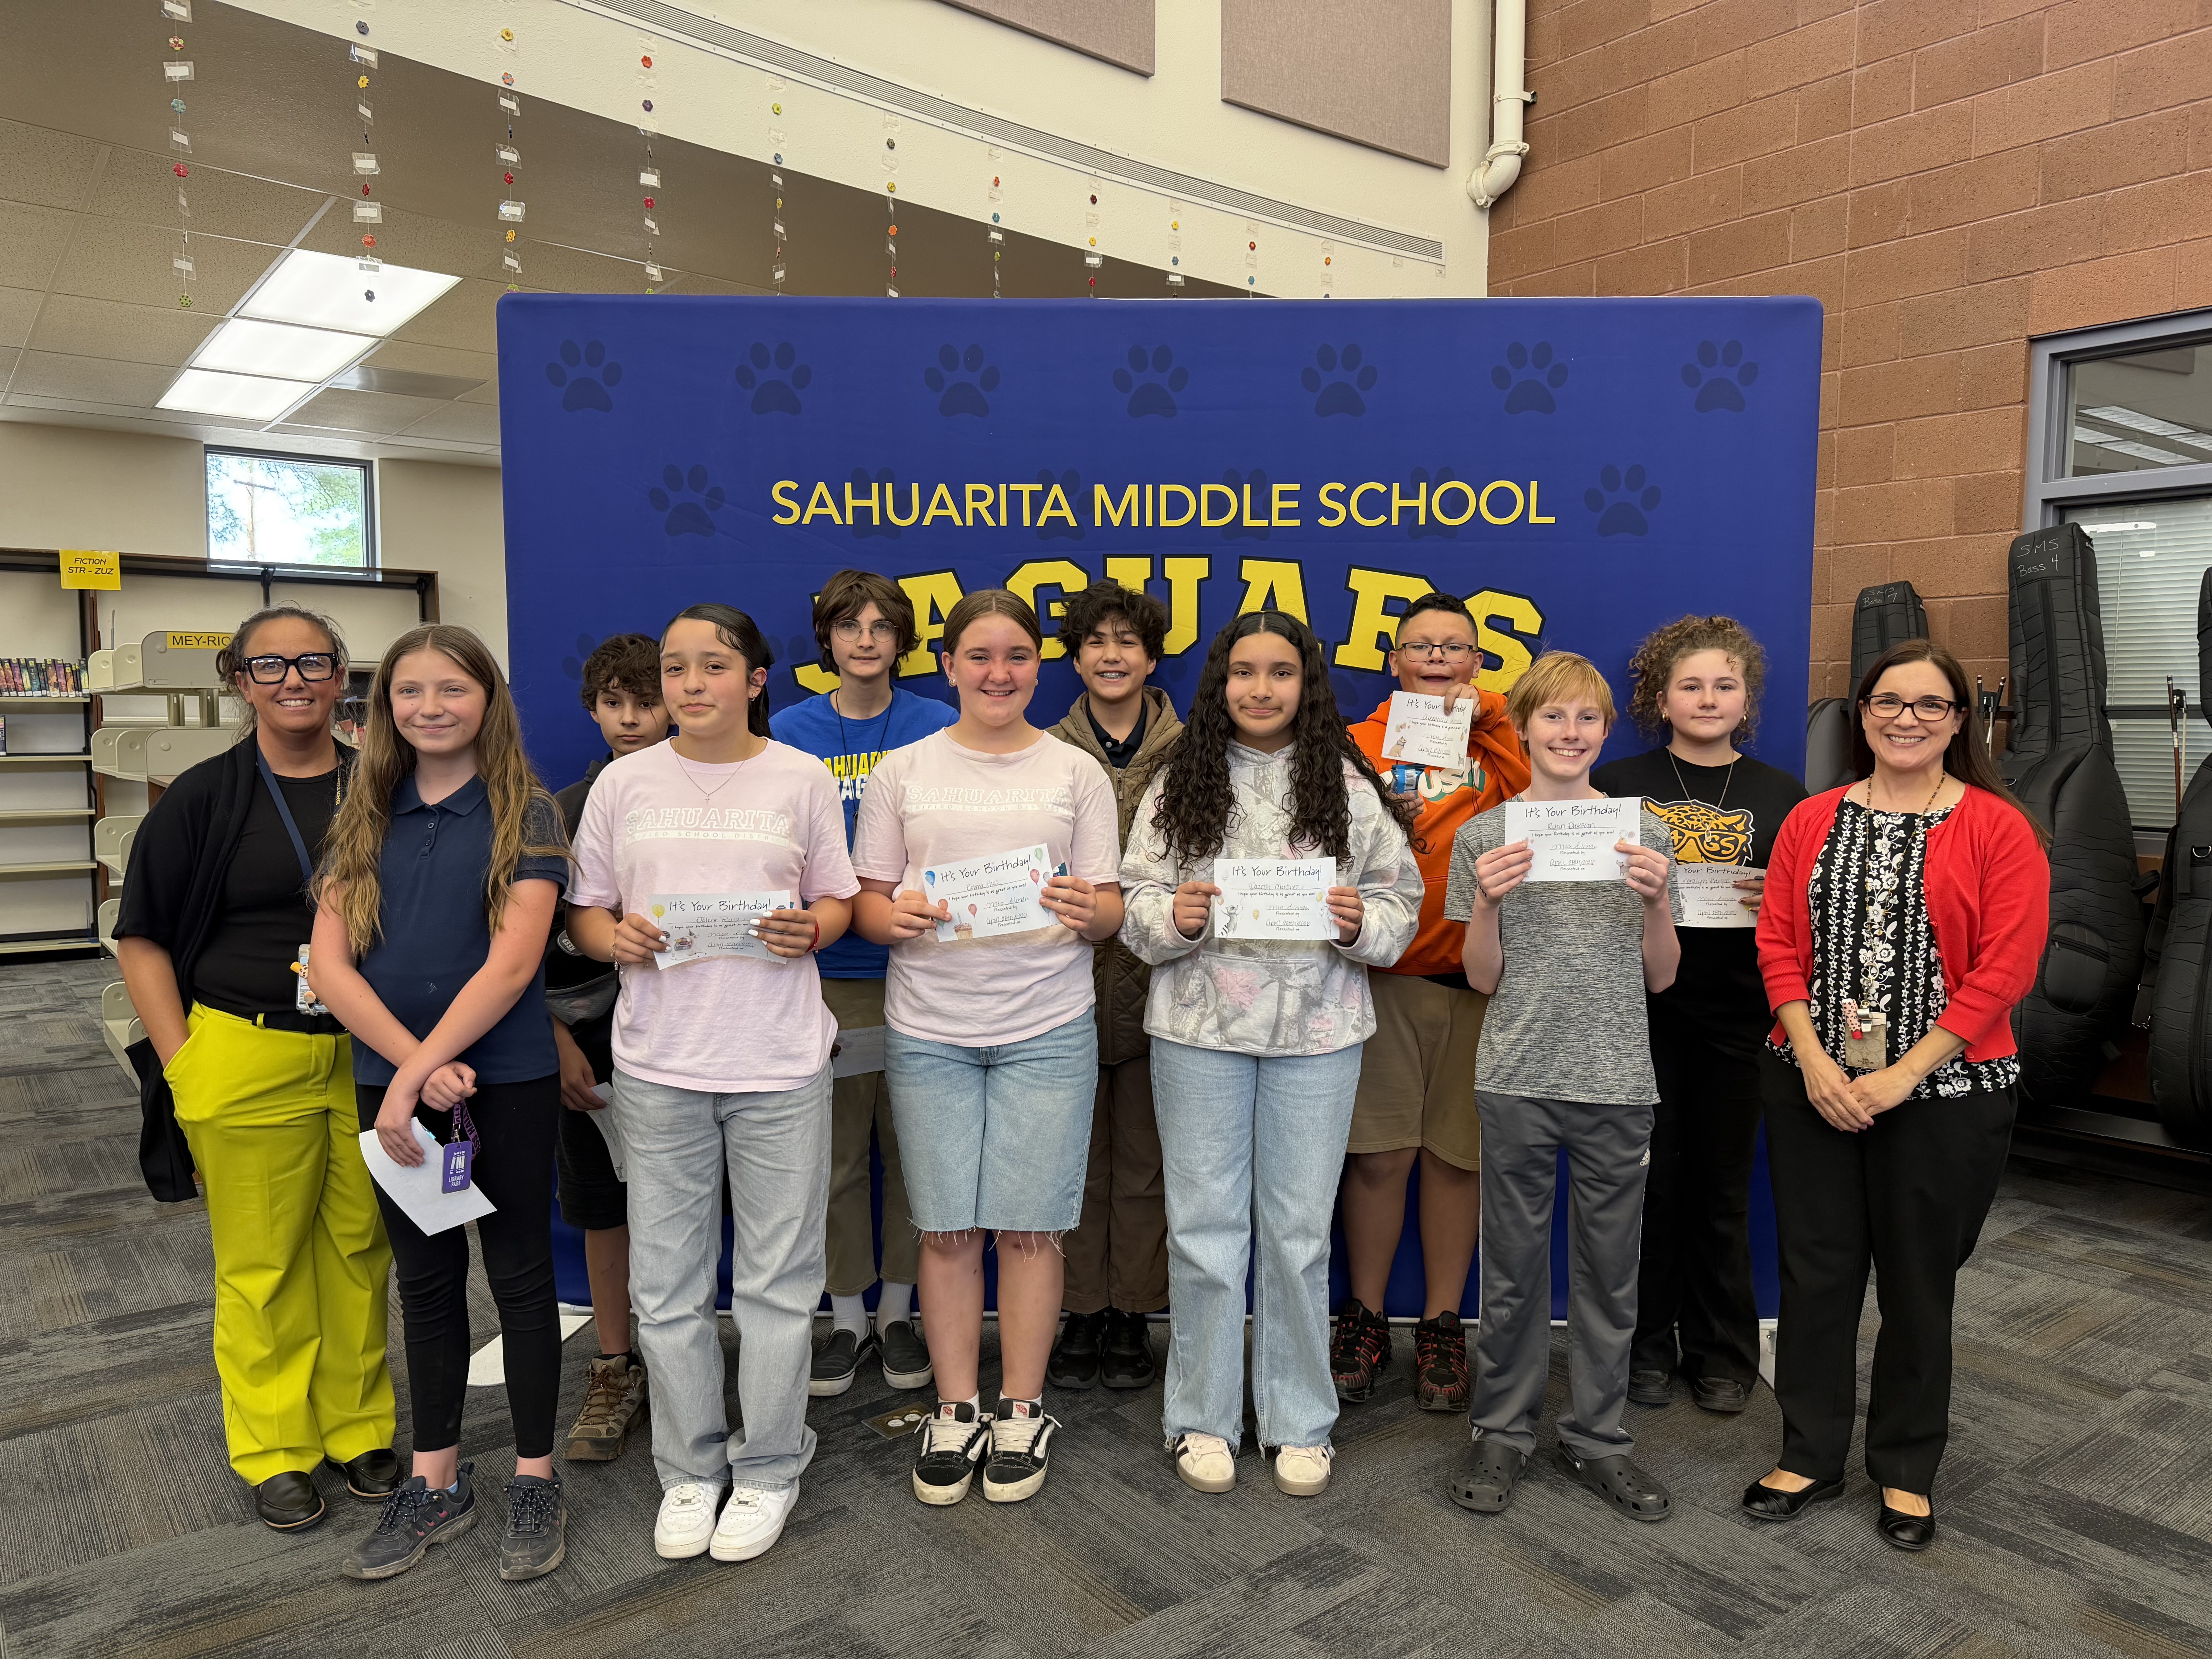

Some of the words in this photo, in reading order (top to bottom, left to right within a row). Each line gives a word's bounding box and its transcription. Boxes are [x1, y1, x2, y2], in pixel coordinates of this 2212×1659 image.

[772, 480, 1077, 527] SAHUARITA
[1094, 483, 1301, 527] MIDDLE
[1317, 480, 1556, 527] SCHOOL
[2016, 538, 2059, 557] SMS
[2017, 564, 2046, 577] Bass
[2052, 554, 2059, 571] 4
[1869, 586, 1894, 595] SMS
[1862, 597, 1882, 608] Bass
[1887, 593, 1897, 603] 7
[1407, 698, 1419, 709] It's
[1424, 701, 1441, 710] Your
[824, 750, 893, 781] AHUAR
[907, 786, 1070, 806] SAHUARITA
[1525, 807, 1540, 818] It's
[1546, 807, 1566, 817] Your
[1571, 803, 1621, 819] Birthday!
[626, 808, 789, 835] SAHUARITA
[1548, 823, 1565, 832] Ryan
[941, 870, 956, 882] It's
[959, 867, 980, 878] Your
[984, 854, 1030, 873] Birthday!
[1233, 866, 1247, 877] It's
[1252, 866, 1271, 876] Your
[1276, 865, 1322, 881] Birthday!
[1707, 867, 1751, 878] Birthday!
[670, 901, 685, 911] It's
[691, 901, 714, 912] Your
[719, 898, 771, 911] Birthday!
[998, 919, 1015, 927] Presented
[448, 1174, 464, 1182] LIBRARY
